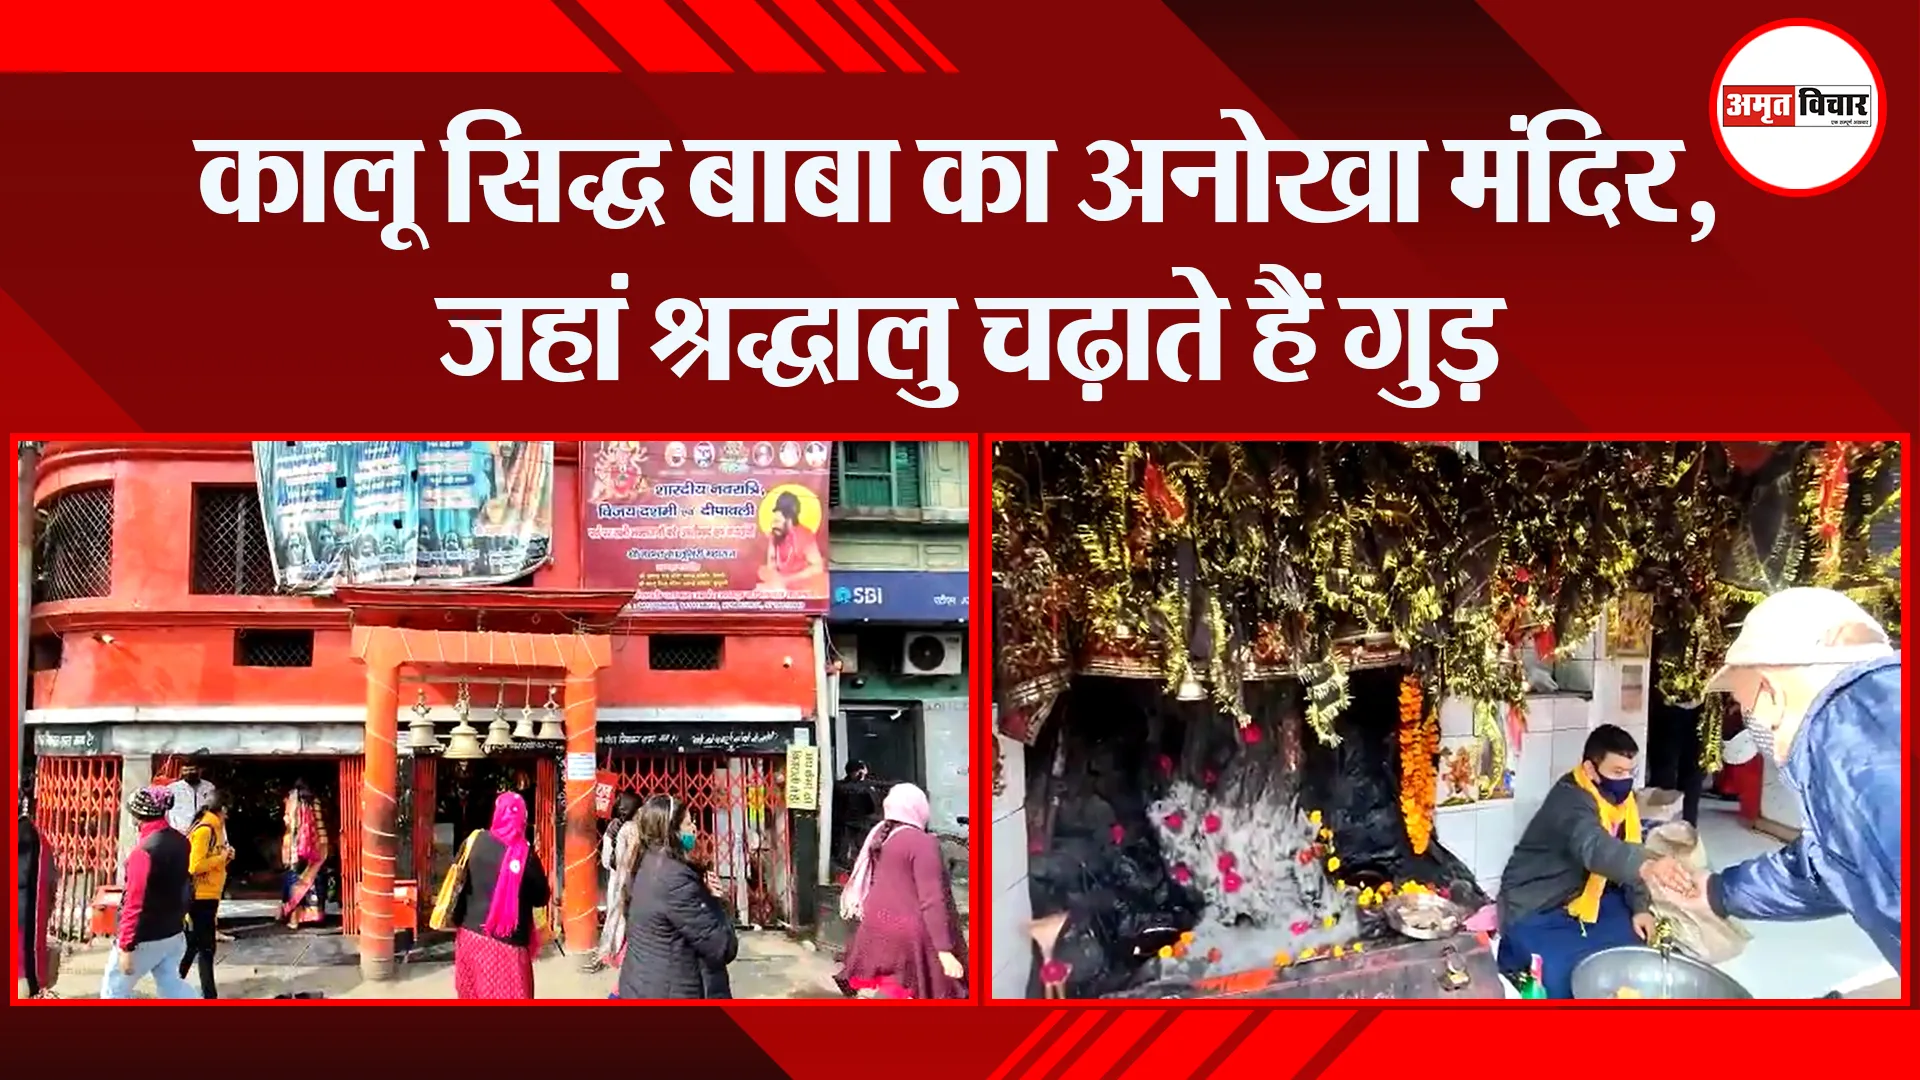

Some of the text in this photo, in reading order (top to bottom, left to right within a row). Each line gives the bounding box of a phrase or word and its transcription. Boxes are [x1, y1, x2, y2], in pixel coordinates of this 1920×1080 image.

[655, 481, 706, 496] शारदीय
[598, 503, 636, 518] विजय
[639, 502, 677, 517] दशमी
[700, 502, 755, 517] दीपावली
[853, 586, 882, 604] SBI
